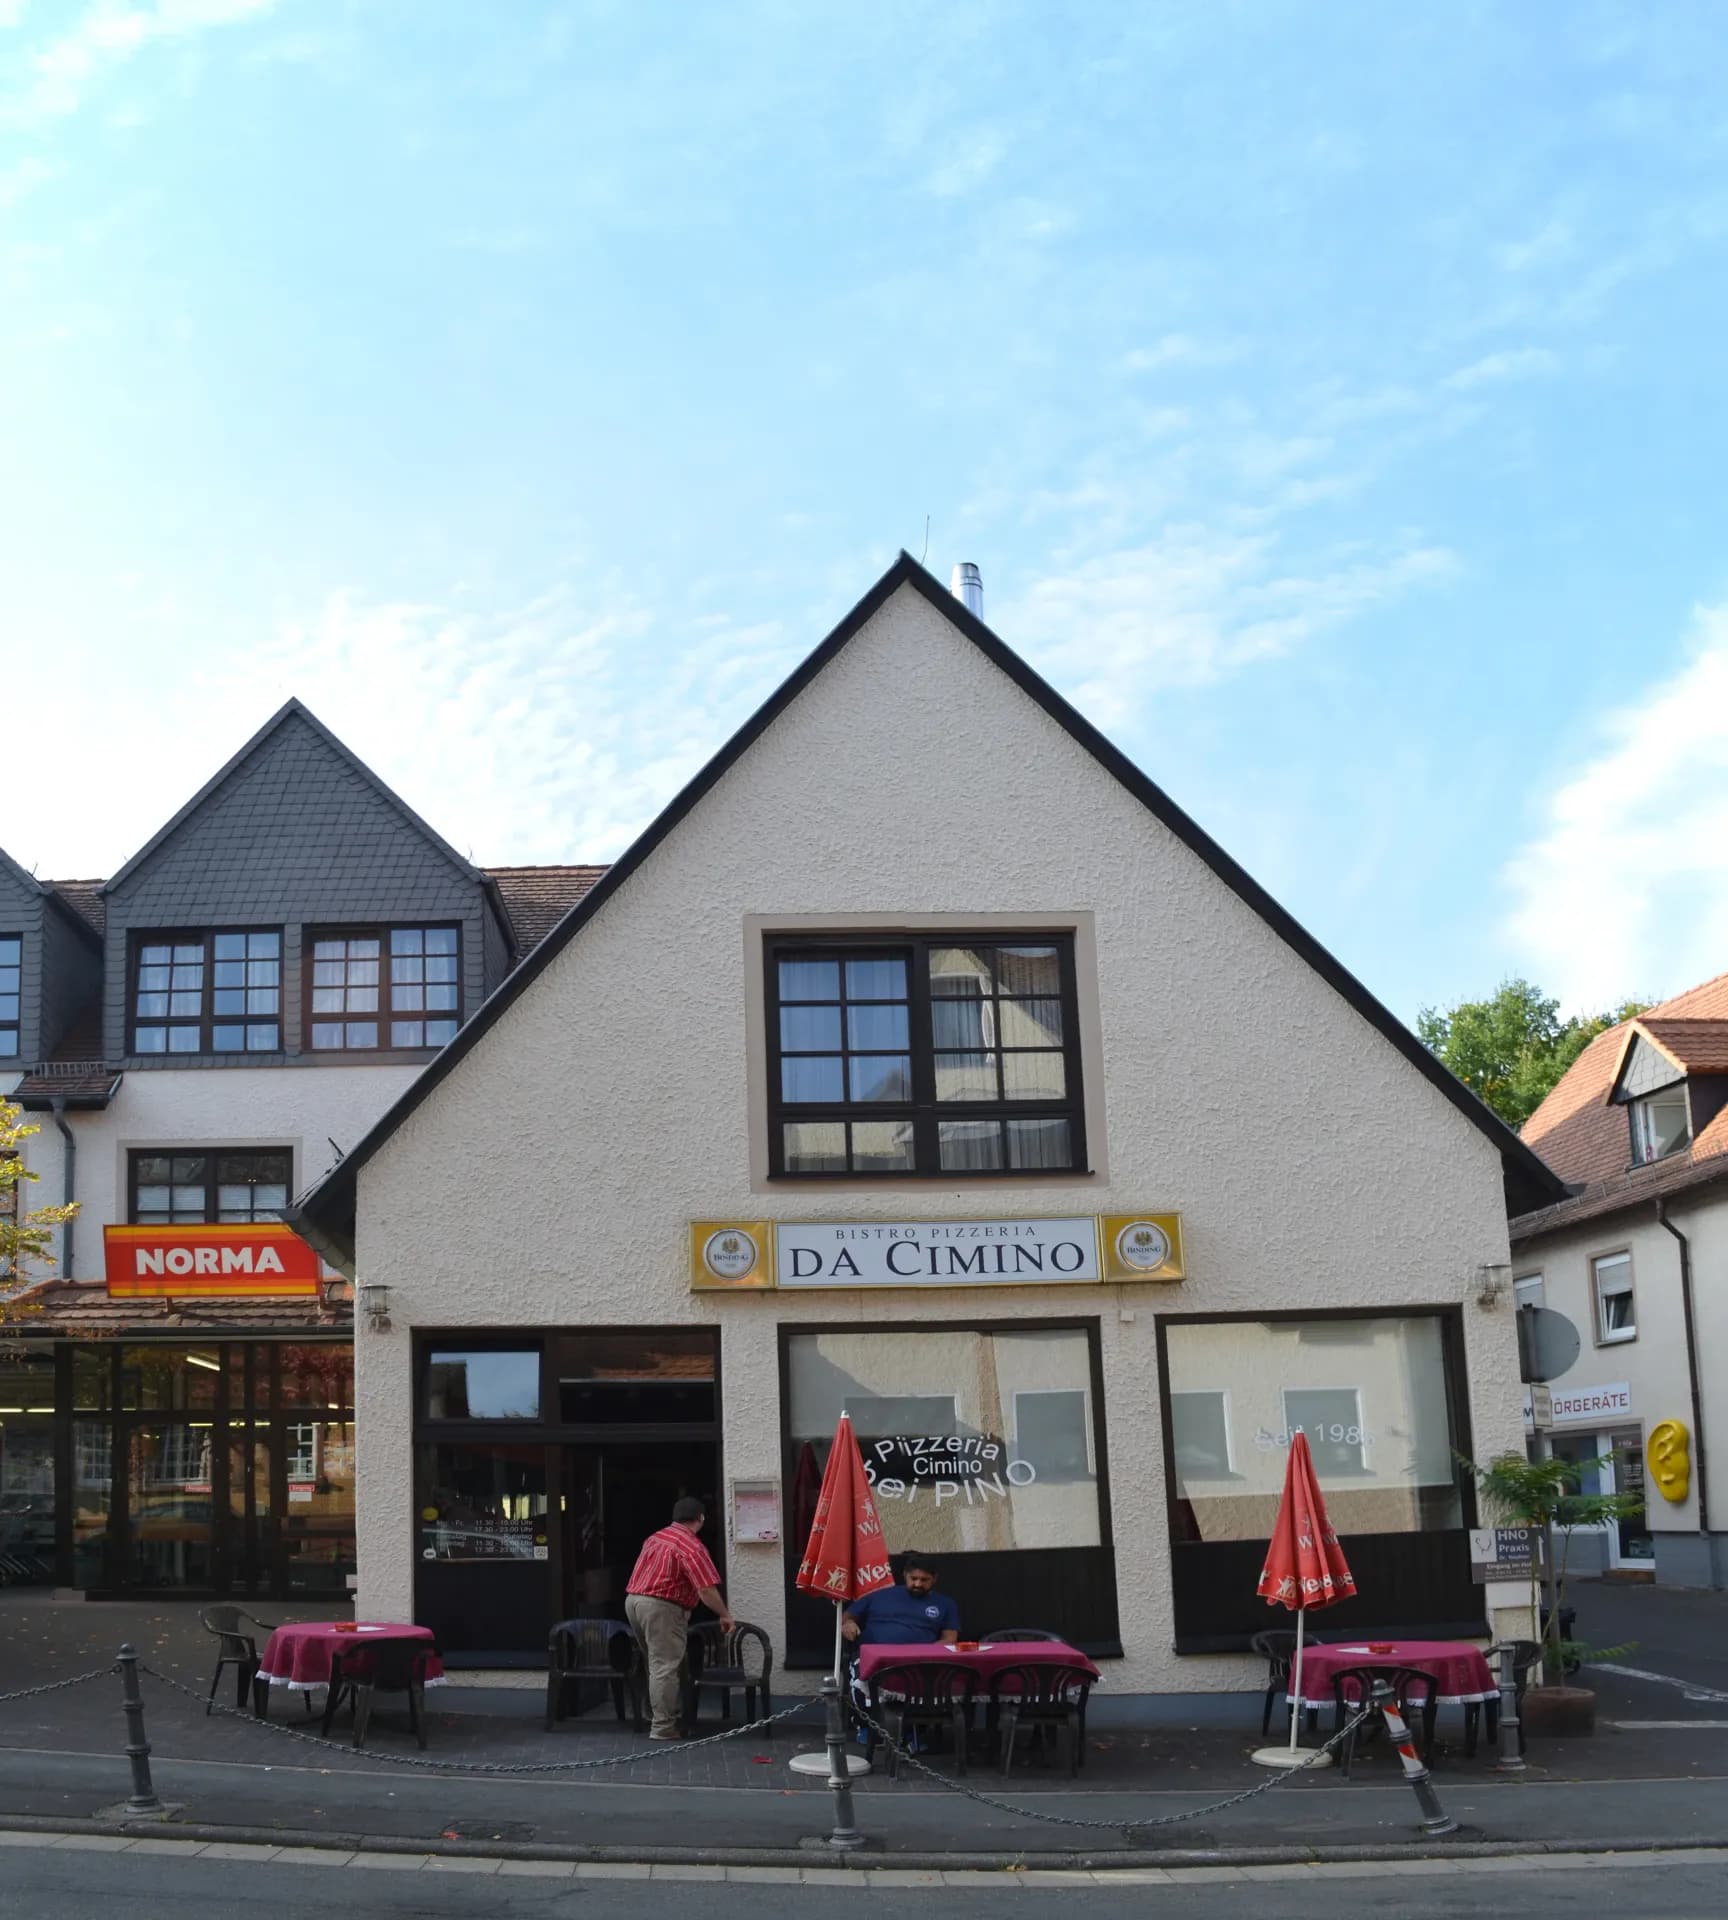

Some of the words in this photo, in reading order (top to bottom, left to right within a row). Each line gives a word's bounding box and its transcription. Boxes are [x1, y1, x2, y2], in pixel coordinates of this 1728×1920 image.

[836, 1228, 916, 1240] BISTRO
[931, 1226, 1037, 1238] PIZZERIA
[135, 1246, 285, 1275] NORMA
[790, 1247, 862, 1278] DA
[886, 1240, 1086, 1277] CIMINO
[1551, 1391, 1628, 1415] ÖRGERÄTE
[874, 1435, 1000, 1463] Pizzeria
[913, 1456, 982, 1475] Cimino
[935, 1460, 1036, 1507] PINO
[1497, 1529, 1528, 1541] HNO
[1498, 1543, 1530, 1552] Praxis
